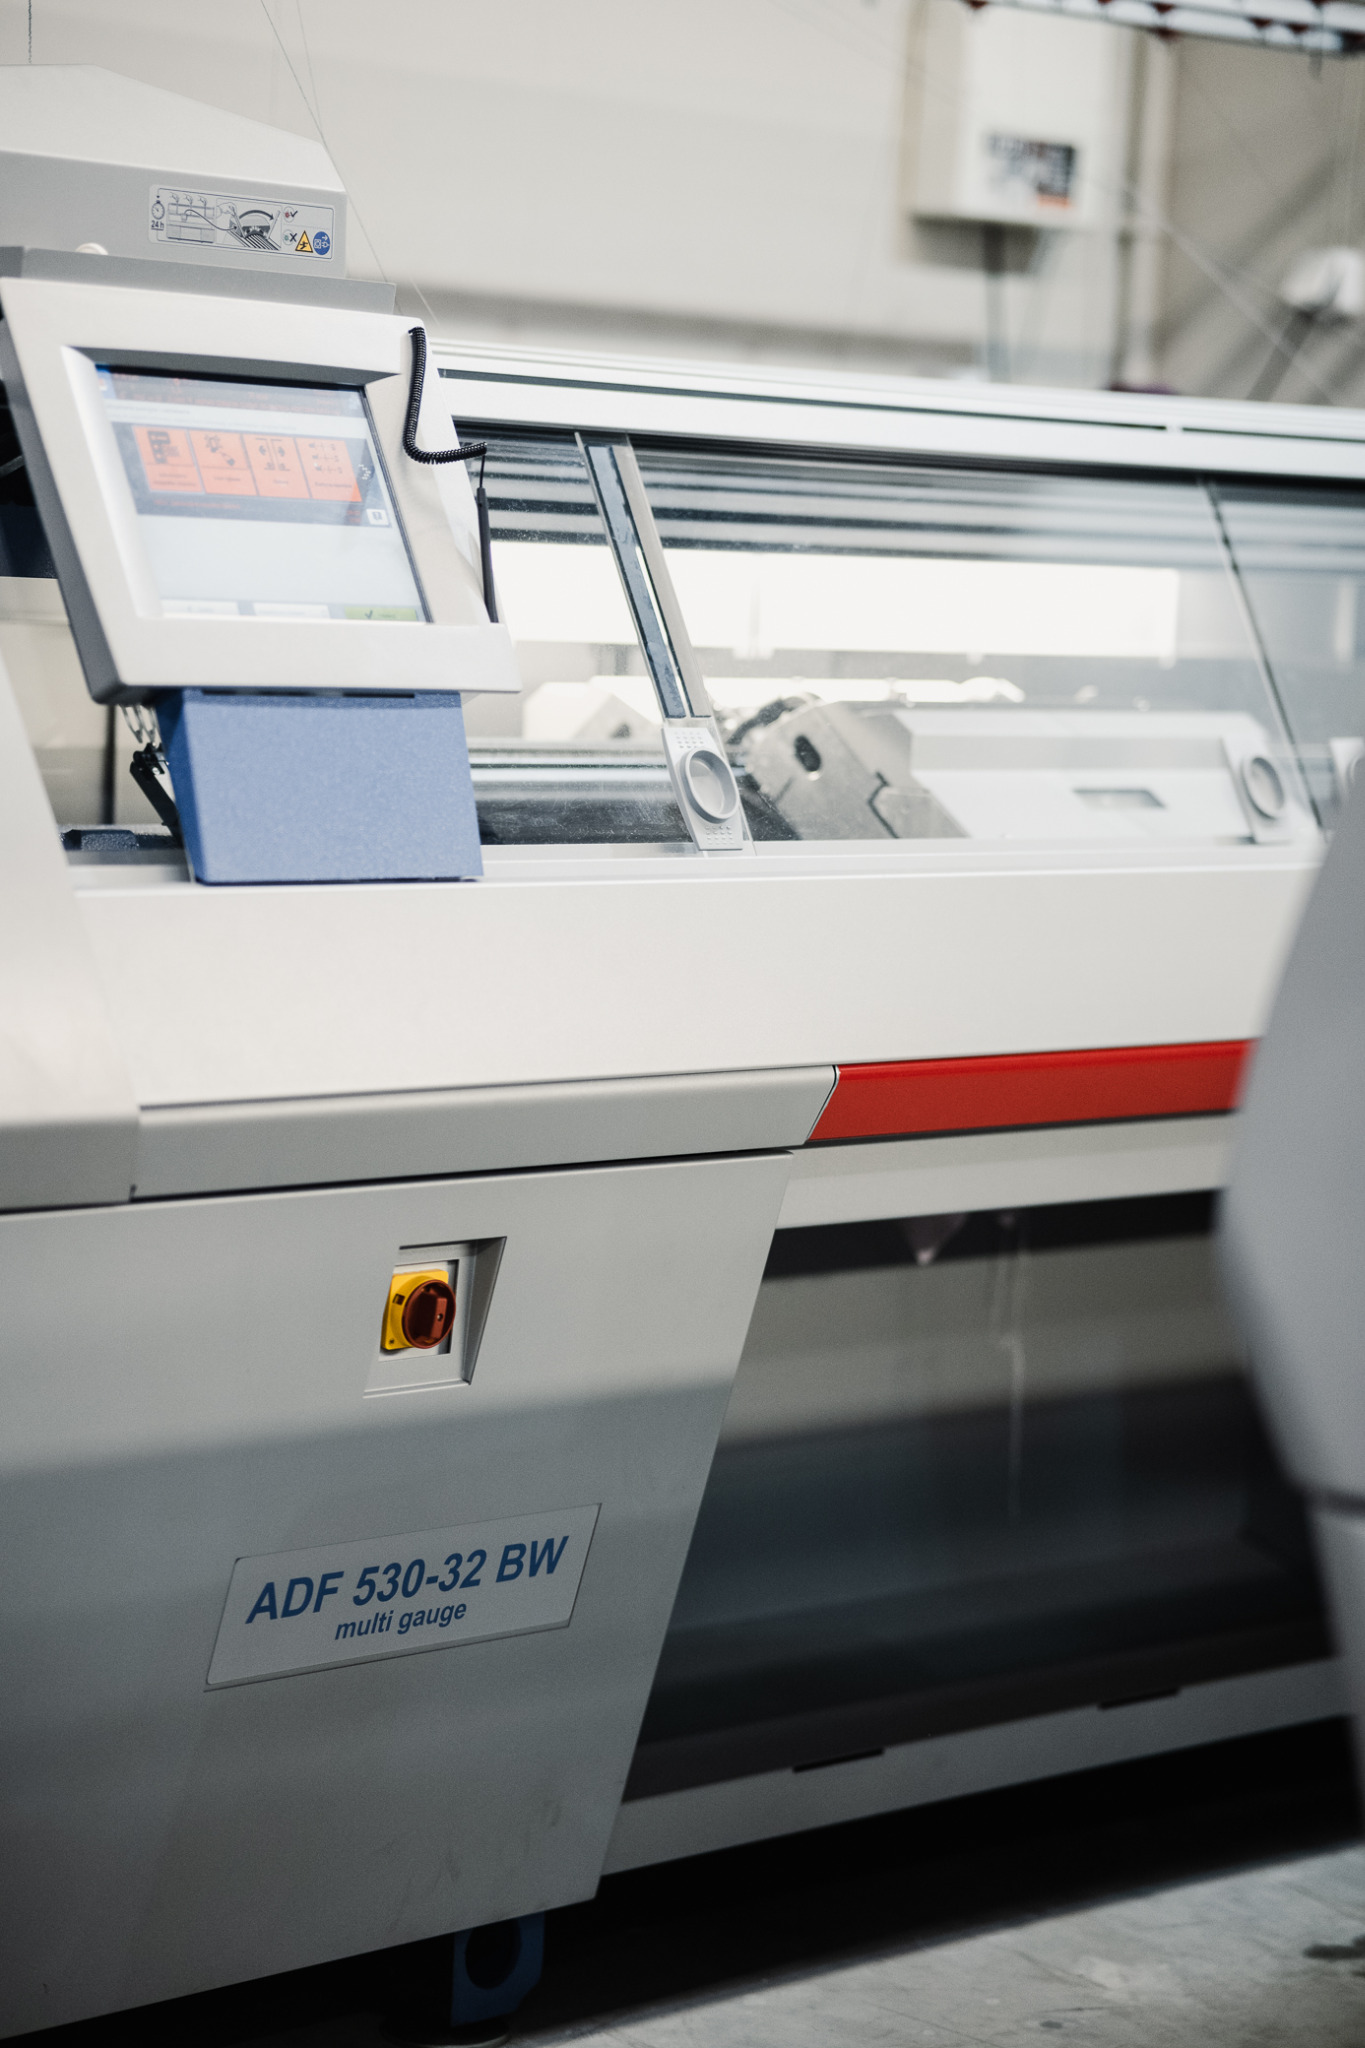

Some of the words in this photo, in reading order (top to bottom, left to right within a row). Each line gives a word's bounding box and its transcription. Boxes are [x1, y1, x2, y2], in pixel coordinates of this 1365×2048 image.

[151, 219, 159, 228] 24
[245, 1571, 345, 1624] ADF
[353, 1549, 487, 1606] 530-32
[496, 1536, 569, 1583] BW
[335, 1610, 394, 1640] multi
[397, 1602, 467, 1635] gauge
